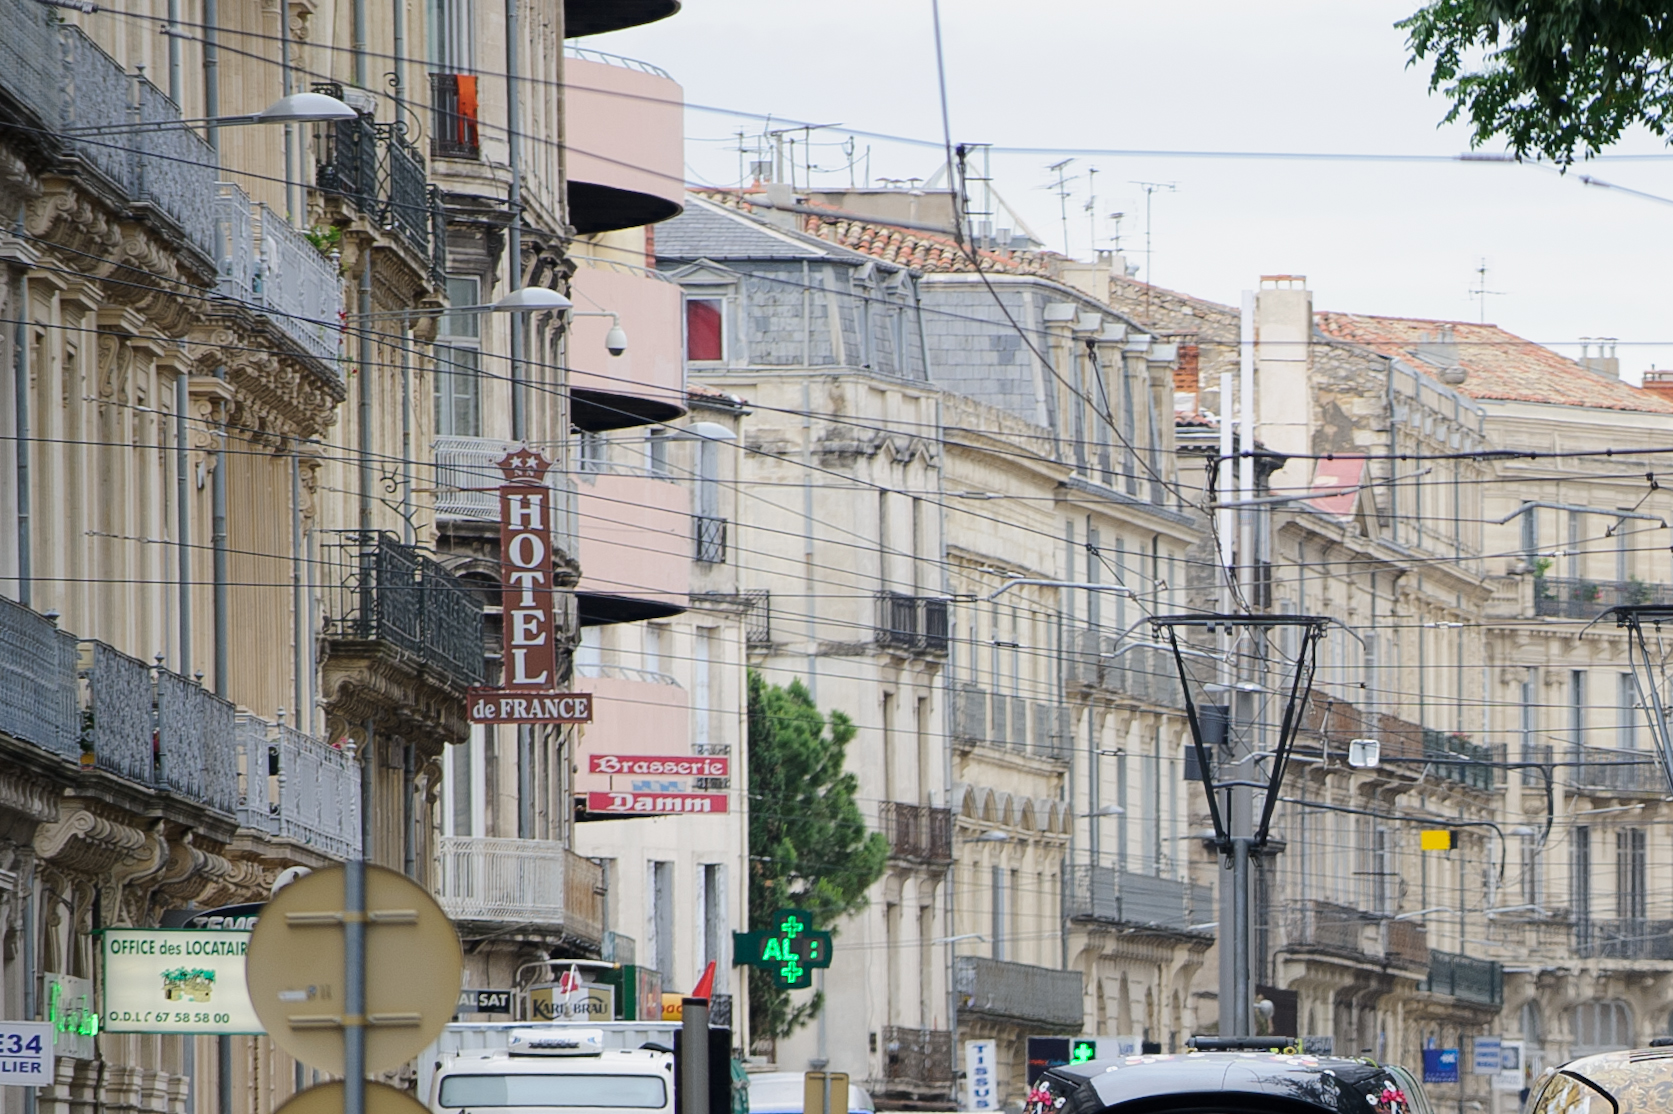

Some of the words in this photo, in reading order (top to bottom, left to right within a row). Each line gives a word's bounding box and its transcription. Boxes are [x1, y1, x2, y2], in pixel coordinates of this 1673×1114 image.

[507, 494, 548, 684] HOTEL
[472, 698, 496, 719] de
[500, 697, 588, 719] FRANCE
[594, 756, 724, 775] Brasserie
[607, 793, 712, 813] Damm
[110, 939, 155, 955] OFFICE
[159, 939, 182, 956] des
[155, 1012, 169, 1023] 67
[174, 1012, 190, 1023] 58
[194, 1012, 210, 1023] 58
[214, 1012, 230, 1023] 00
[0, 1034, 42, 1054] 34
[973, 1043, 990, 1109] TISSUS
